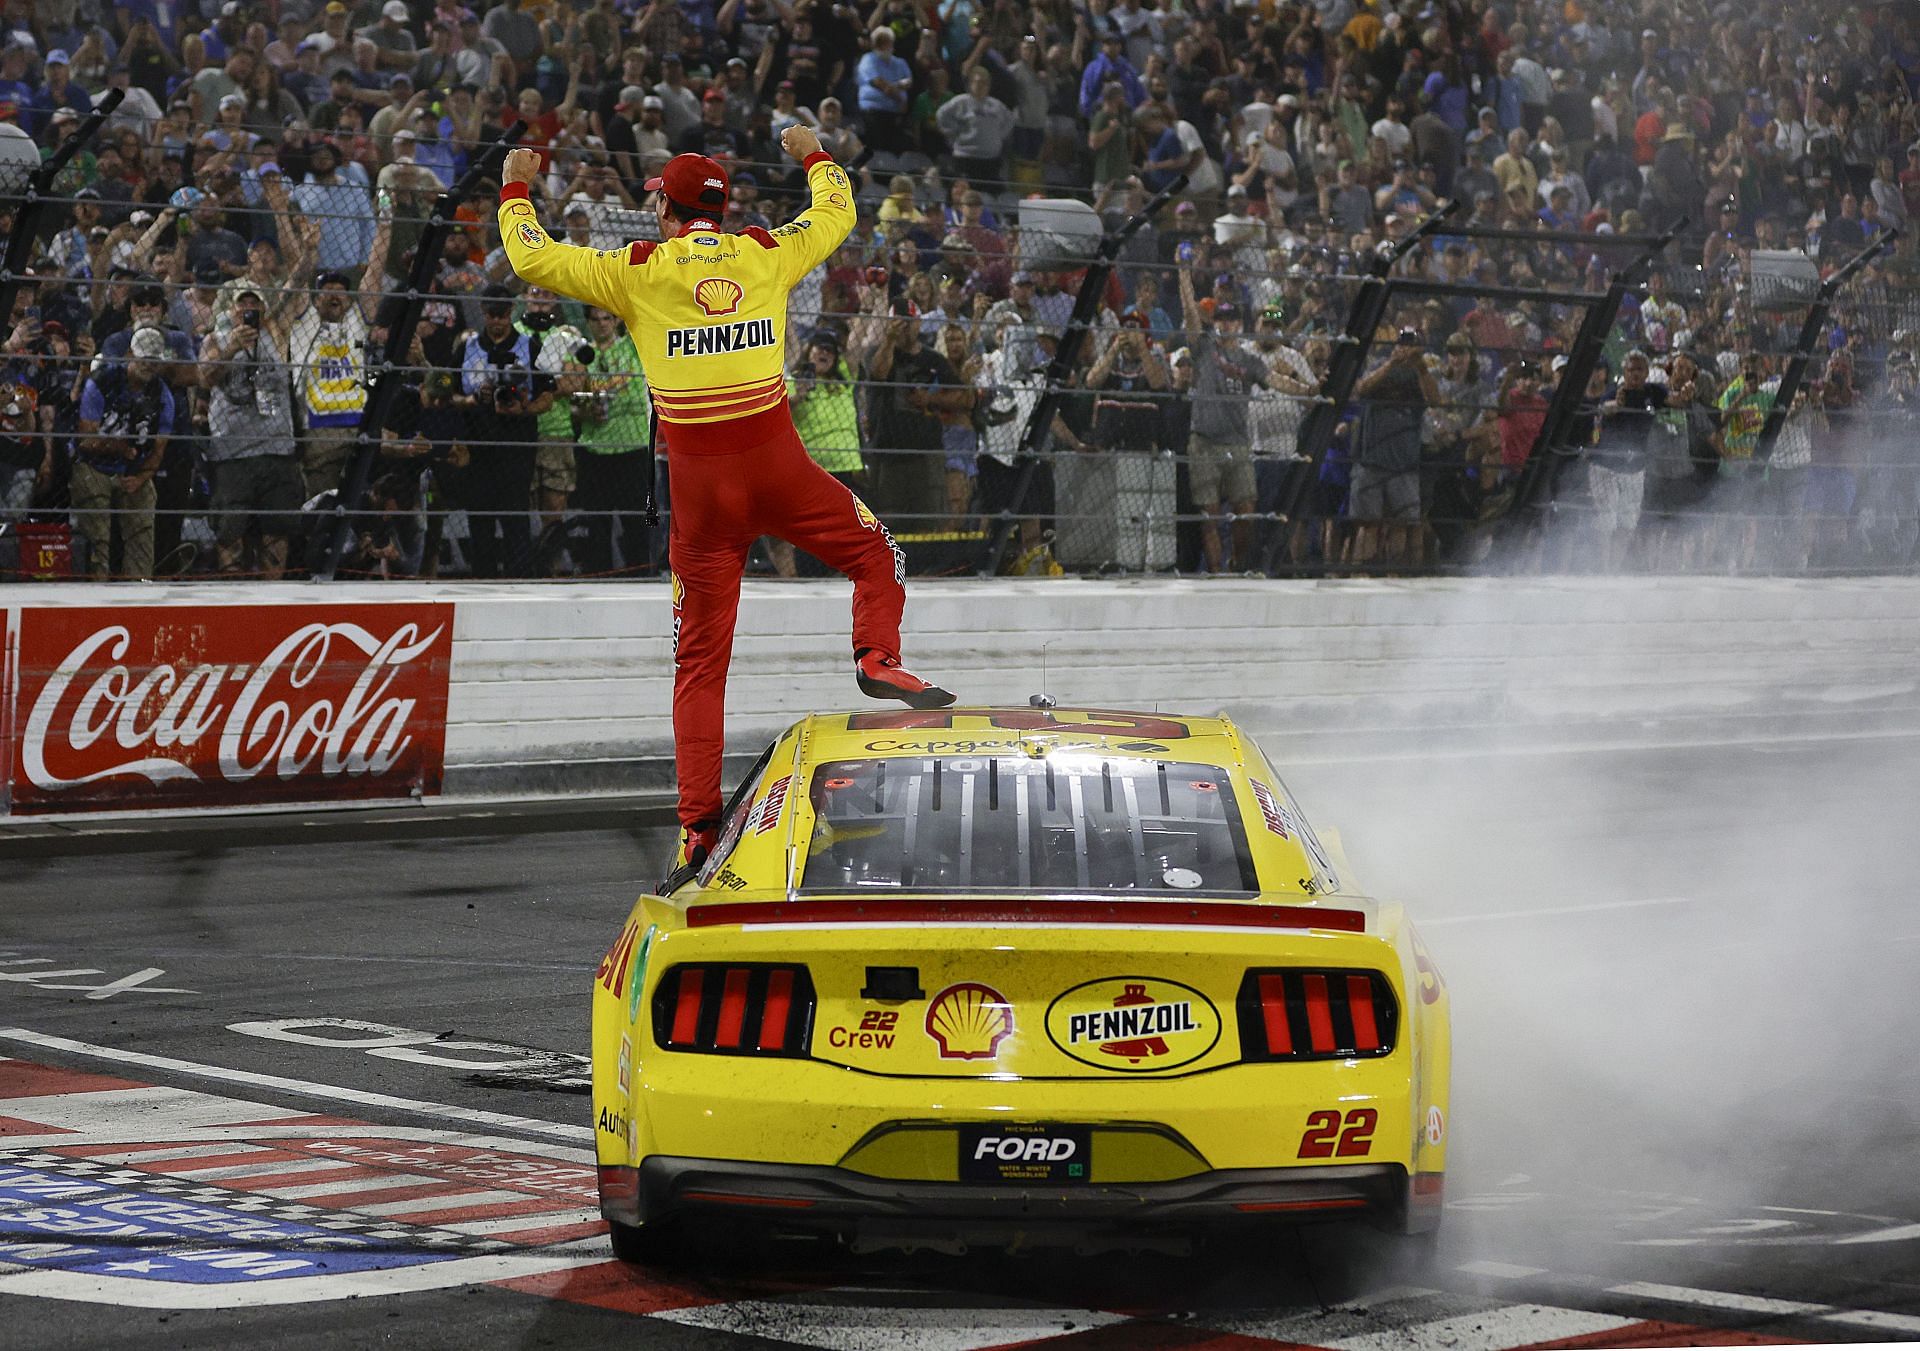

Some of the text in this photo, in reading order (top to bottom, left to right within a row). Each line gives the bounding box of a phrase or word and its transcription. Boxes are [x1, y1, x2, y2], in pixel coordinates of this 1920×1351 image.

[667, 318, 776, 357] PENNZOIL
[22, 621, 445, 790] Coca-Cola
[828, 1026, 896, 1049] Crew
[859, 1011, 899, 1031] 22
[1070, 1002, 1196, 1043] PENNZOIL
[974, 1137, 1076, 1161] FORD
[1298, 1109, 1378, 1158] 22
